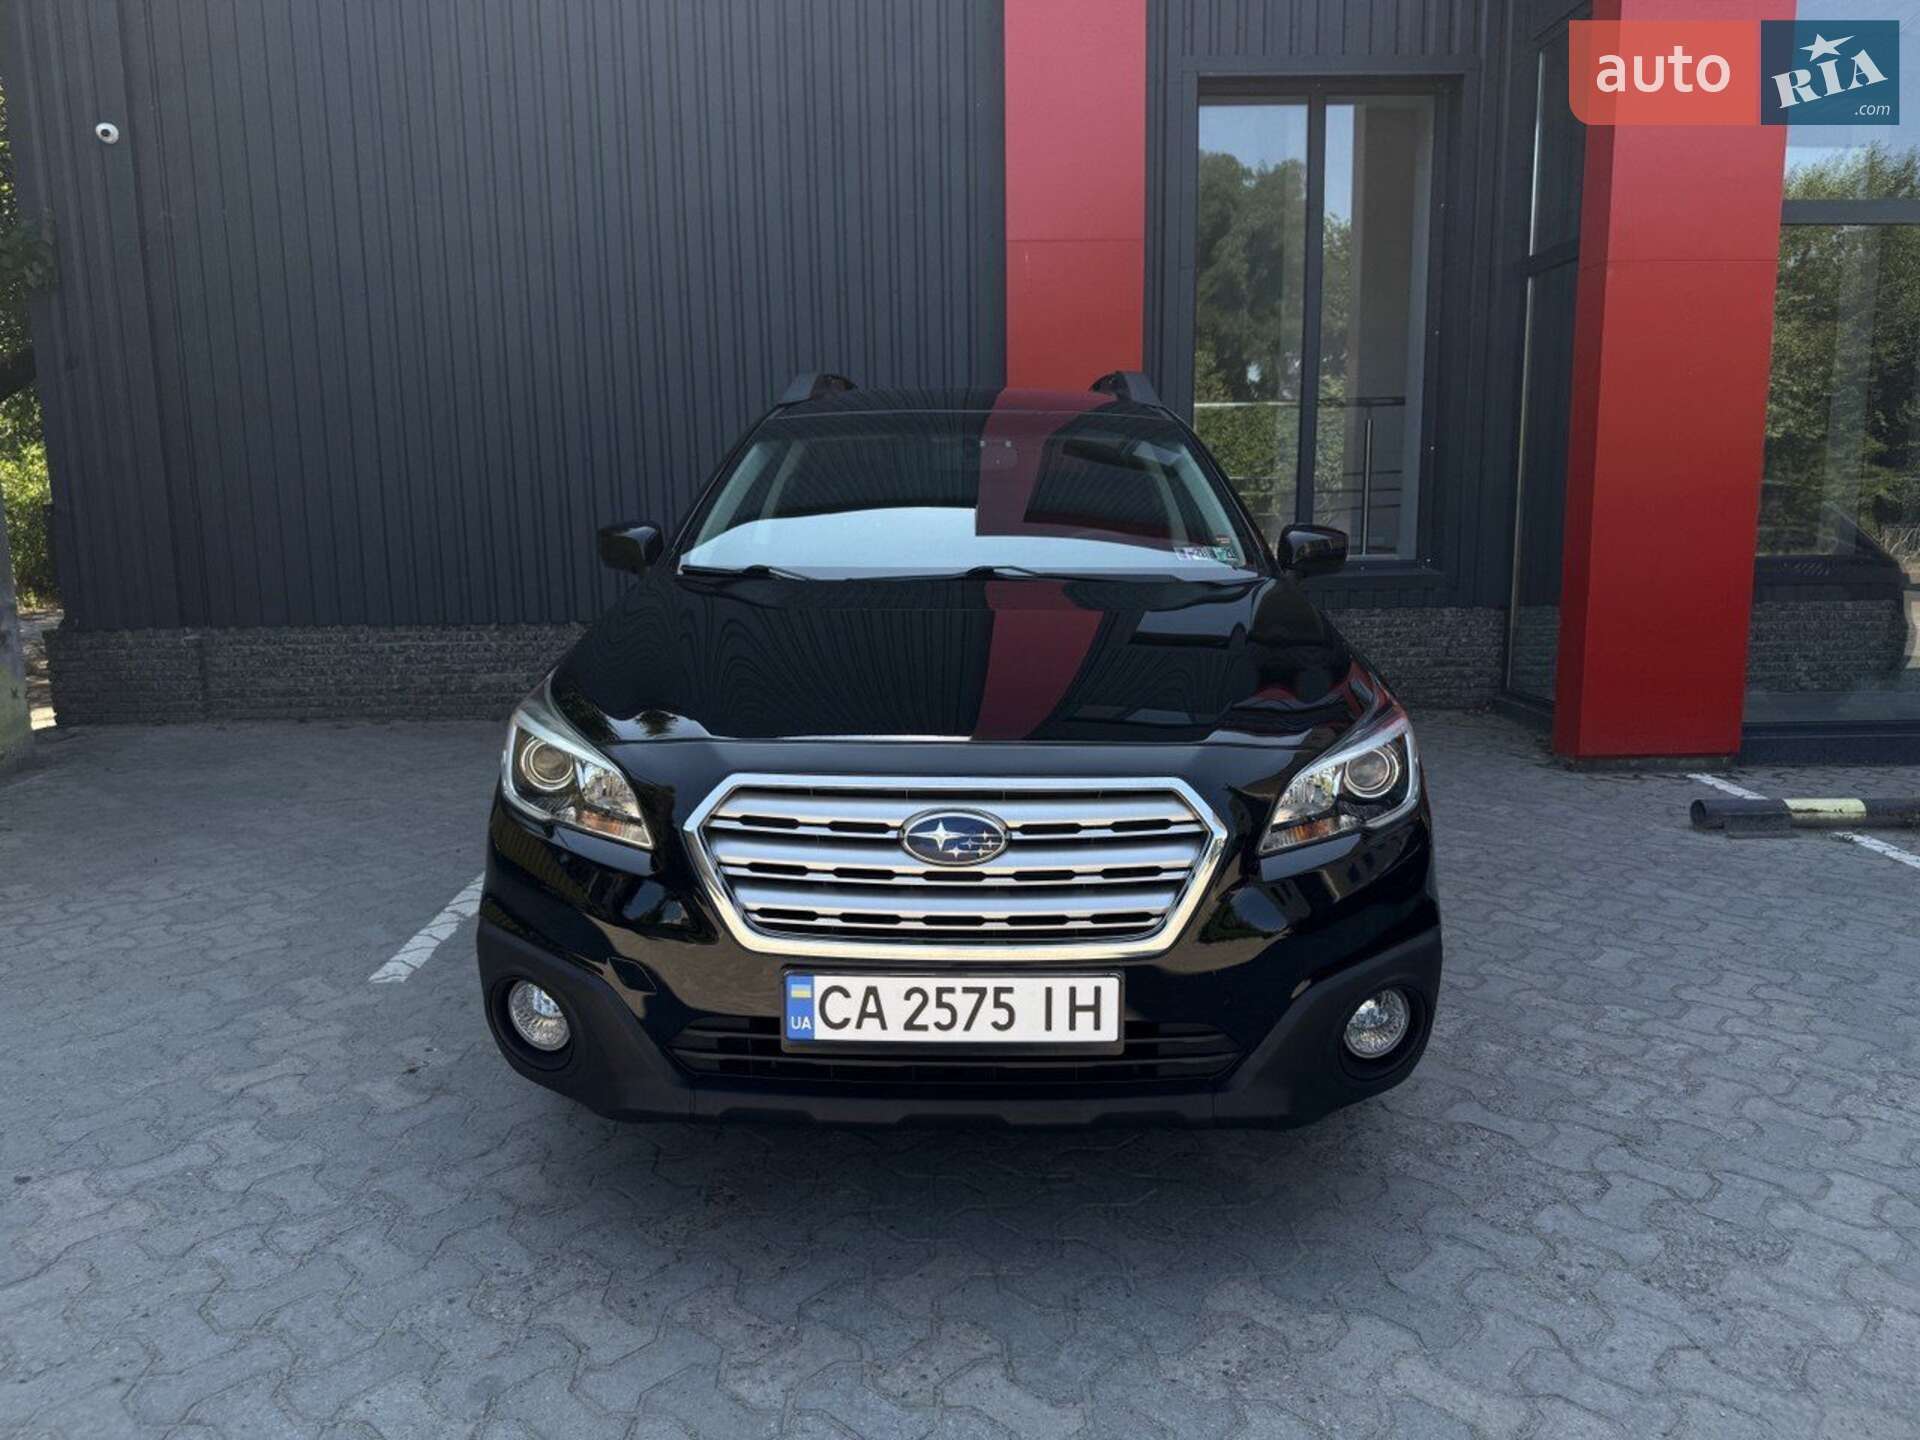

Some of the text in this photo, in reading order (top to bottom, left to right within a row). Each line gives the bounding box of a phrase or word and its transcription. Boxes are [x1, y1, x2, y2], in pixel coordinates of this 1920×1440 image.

[791, 1016, 812, 1030] UA
[818, 985, 1101, 1032] CA 2575 IH
